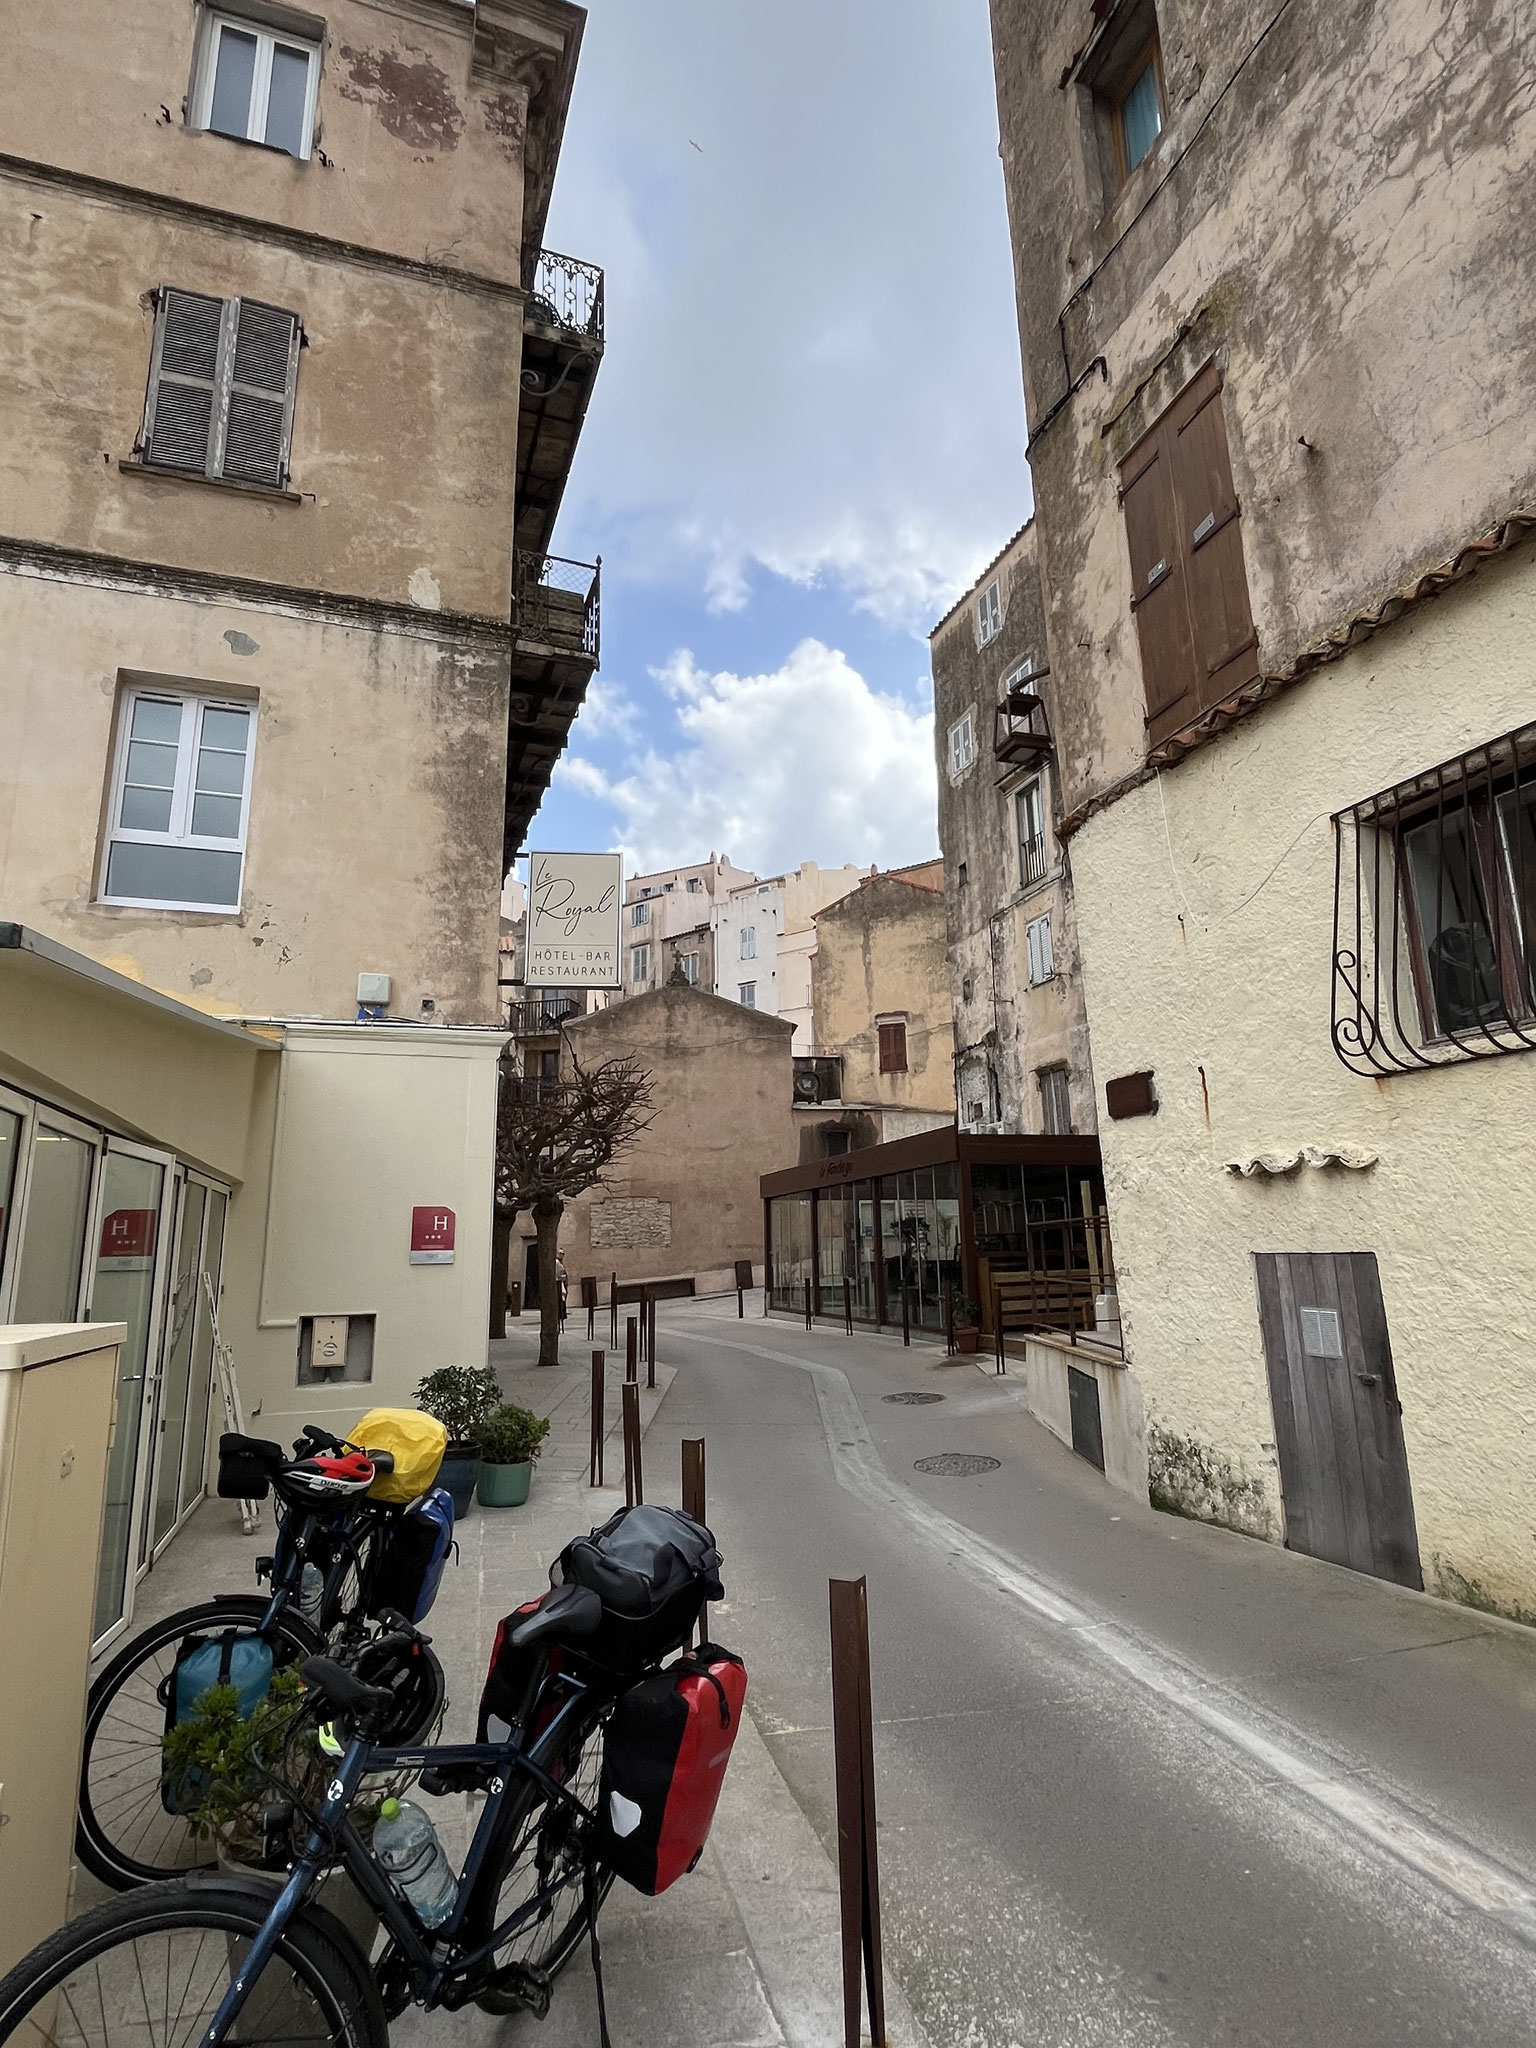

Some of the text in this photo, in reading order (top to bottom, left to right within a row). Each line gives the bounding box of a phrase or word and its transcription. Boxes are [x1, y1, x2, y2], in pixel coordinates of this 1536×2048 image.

[536, 858, 552, 885] Le
[534, 878, 615, 936] Royal
[530, 966, 614, 976] RESTAURANT
[433, 1215, 448, 1231] H
